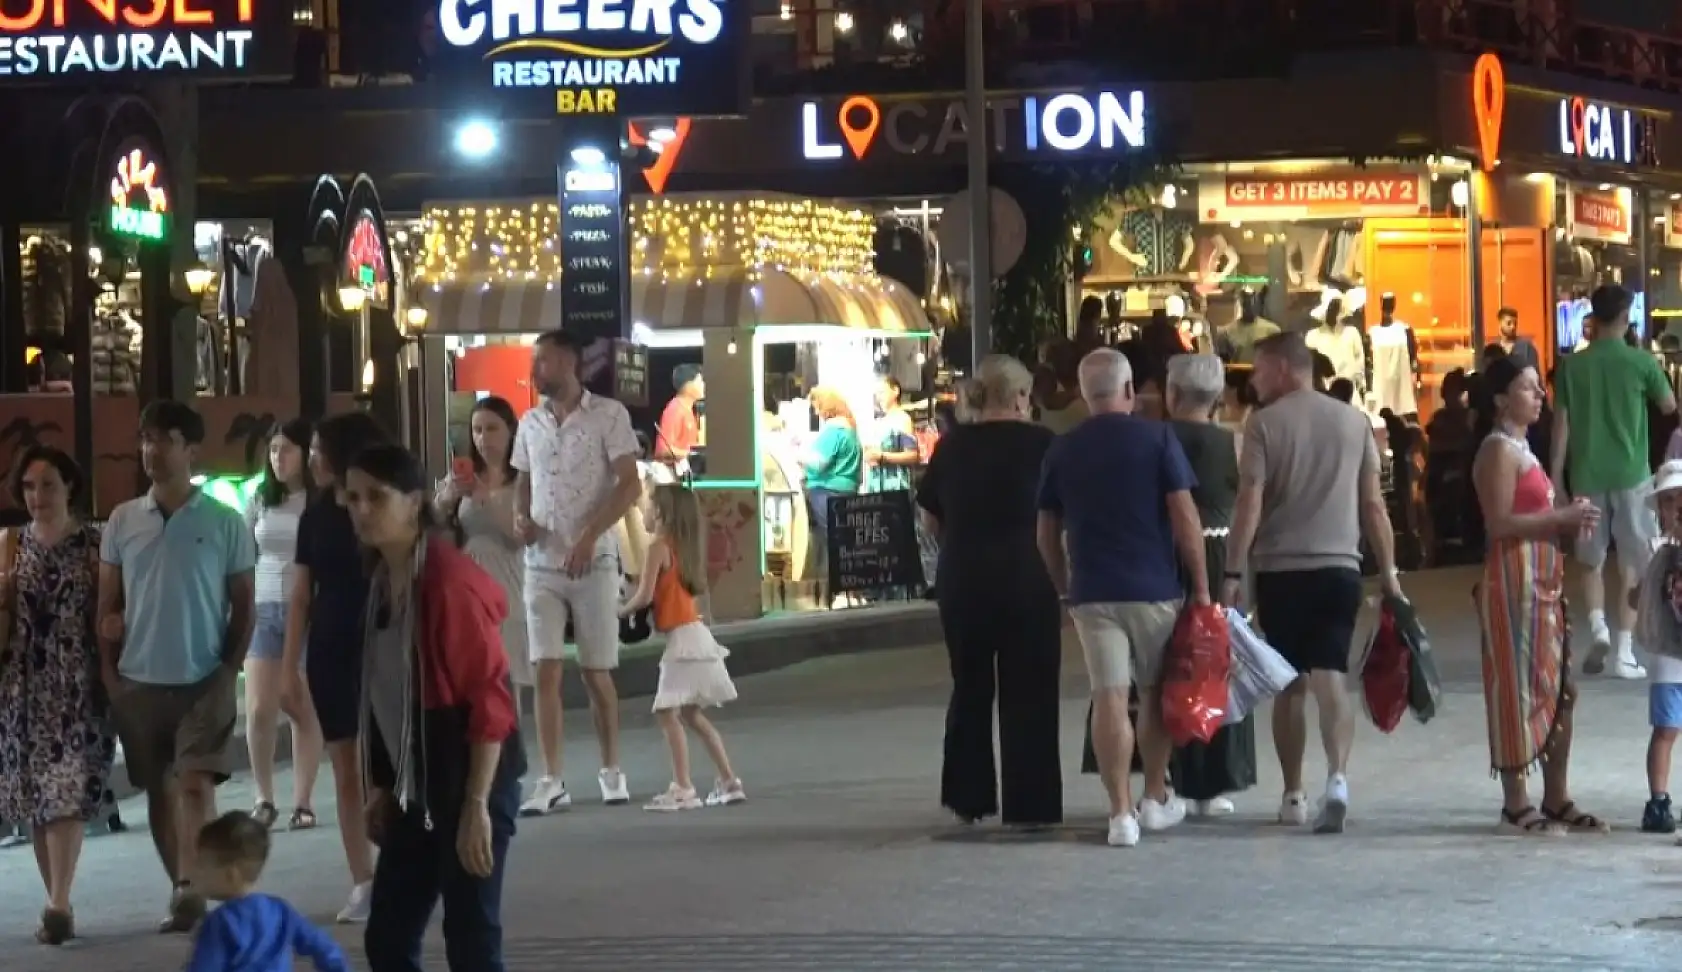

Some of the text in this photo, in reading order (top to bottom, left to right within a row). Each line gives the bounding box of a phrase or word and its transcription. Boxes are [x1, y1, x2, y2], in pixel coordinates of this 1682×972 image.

[492, 57, 680, 86] RESTAURANT
[556, 88, 616, 114] BAR
[1229, 180, 1413, 201] GET 3 ITEMS PAY 2
